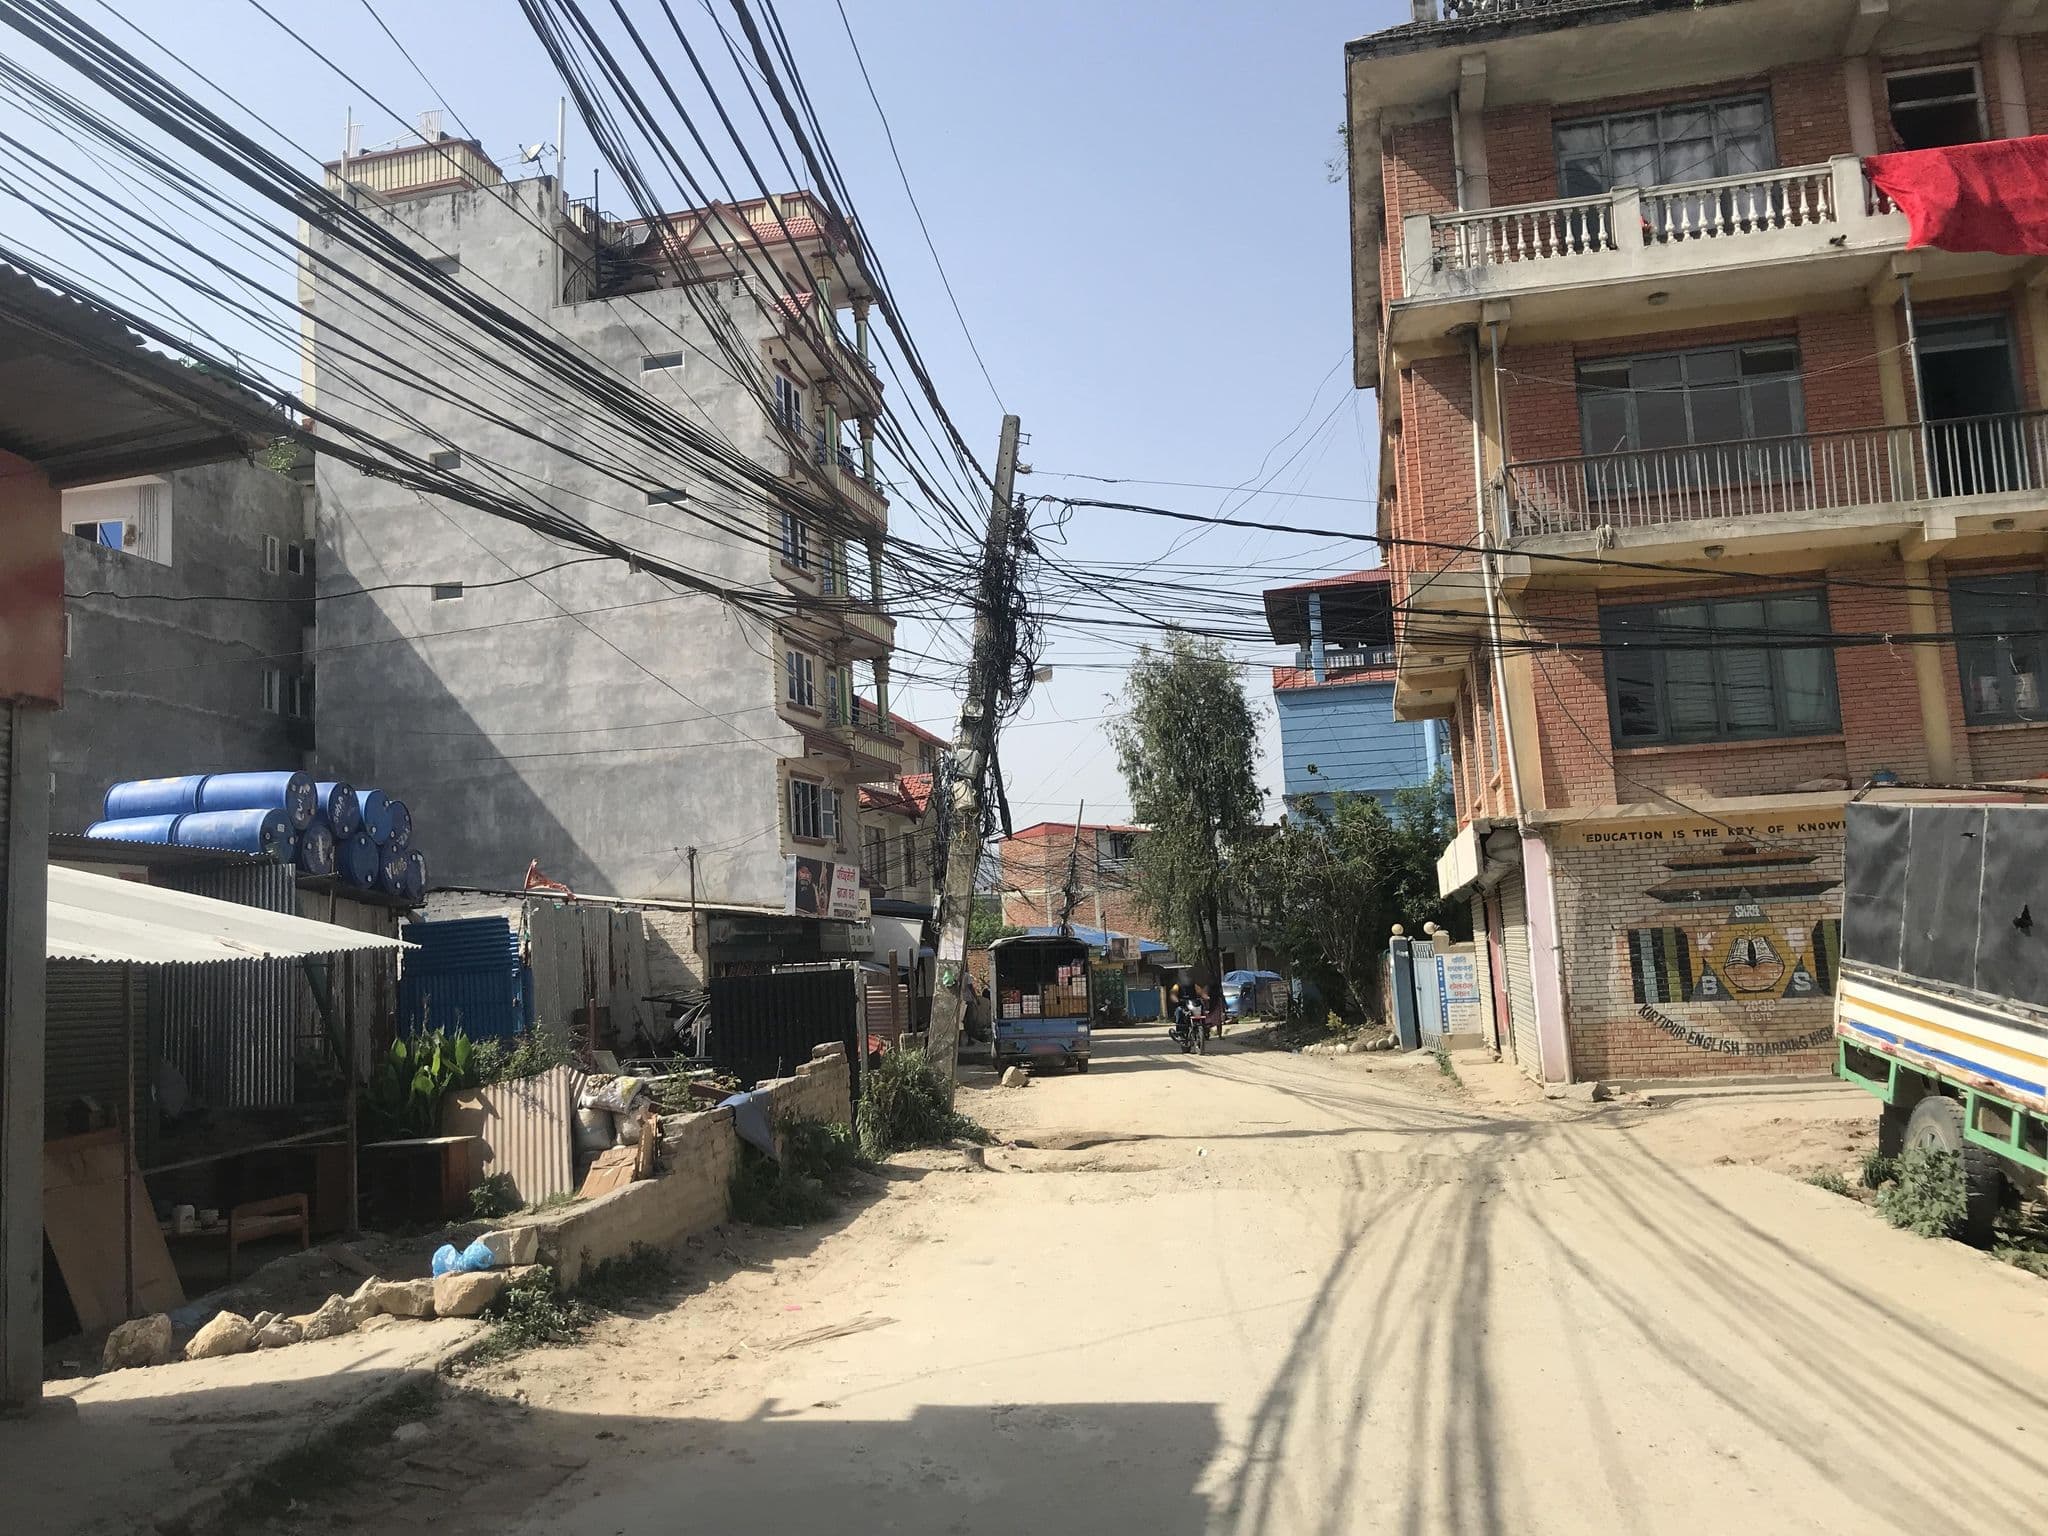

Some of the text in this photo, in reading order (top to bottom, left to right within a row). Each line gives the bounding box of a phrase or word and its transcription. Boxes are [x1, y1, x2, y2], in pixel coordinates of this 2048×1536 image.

[1673, 830, 1685, 838] IS
[1693, 828, 1718, 838] THE
[1728, 827, 1755, 836] KEY
[1768, 825, 1784, 834] OF
[1735, 904, 1760, 917] SHREE
[1701, 975, 1718, 995] B
[1793, 972, 1811, 991] S
[1638, 1003, 1686, 1038] KIRTIPUR
[1686, 1031, 1740, 1055] ENGLISH
[1746, 1035, 1809, 1055] BOARDING
